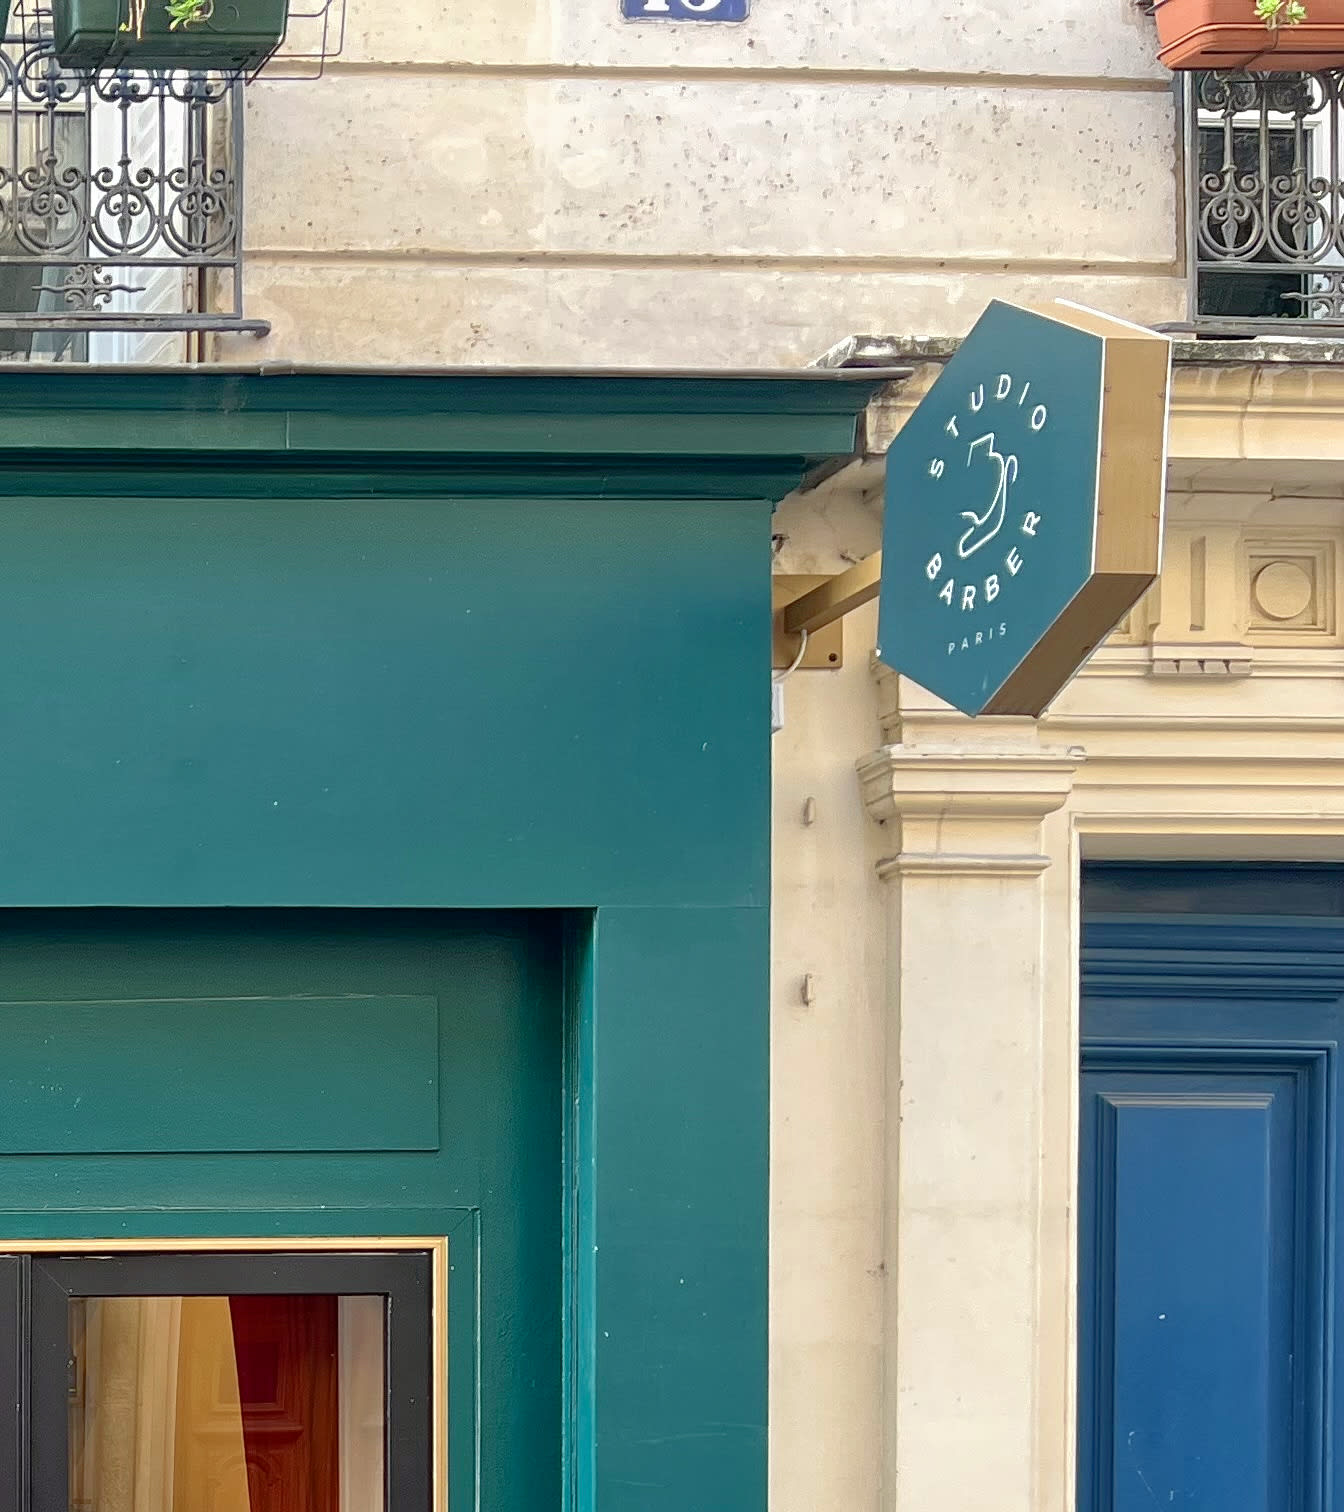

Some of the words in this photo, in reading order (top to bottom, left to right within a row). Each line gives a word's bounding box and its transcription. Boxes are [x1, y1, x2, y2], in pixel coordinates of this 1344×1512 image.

[928, 374, 1047, 479] STUDIO
[925, 510, 1042, 611] BARBER
[947, 622, 1008, 655] PARIS
